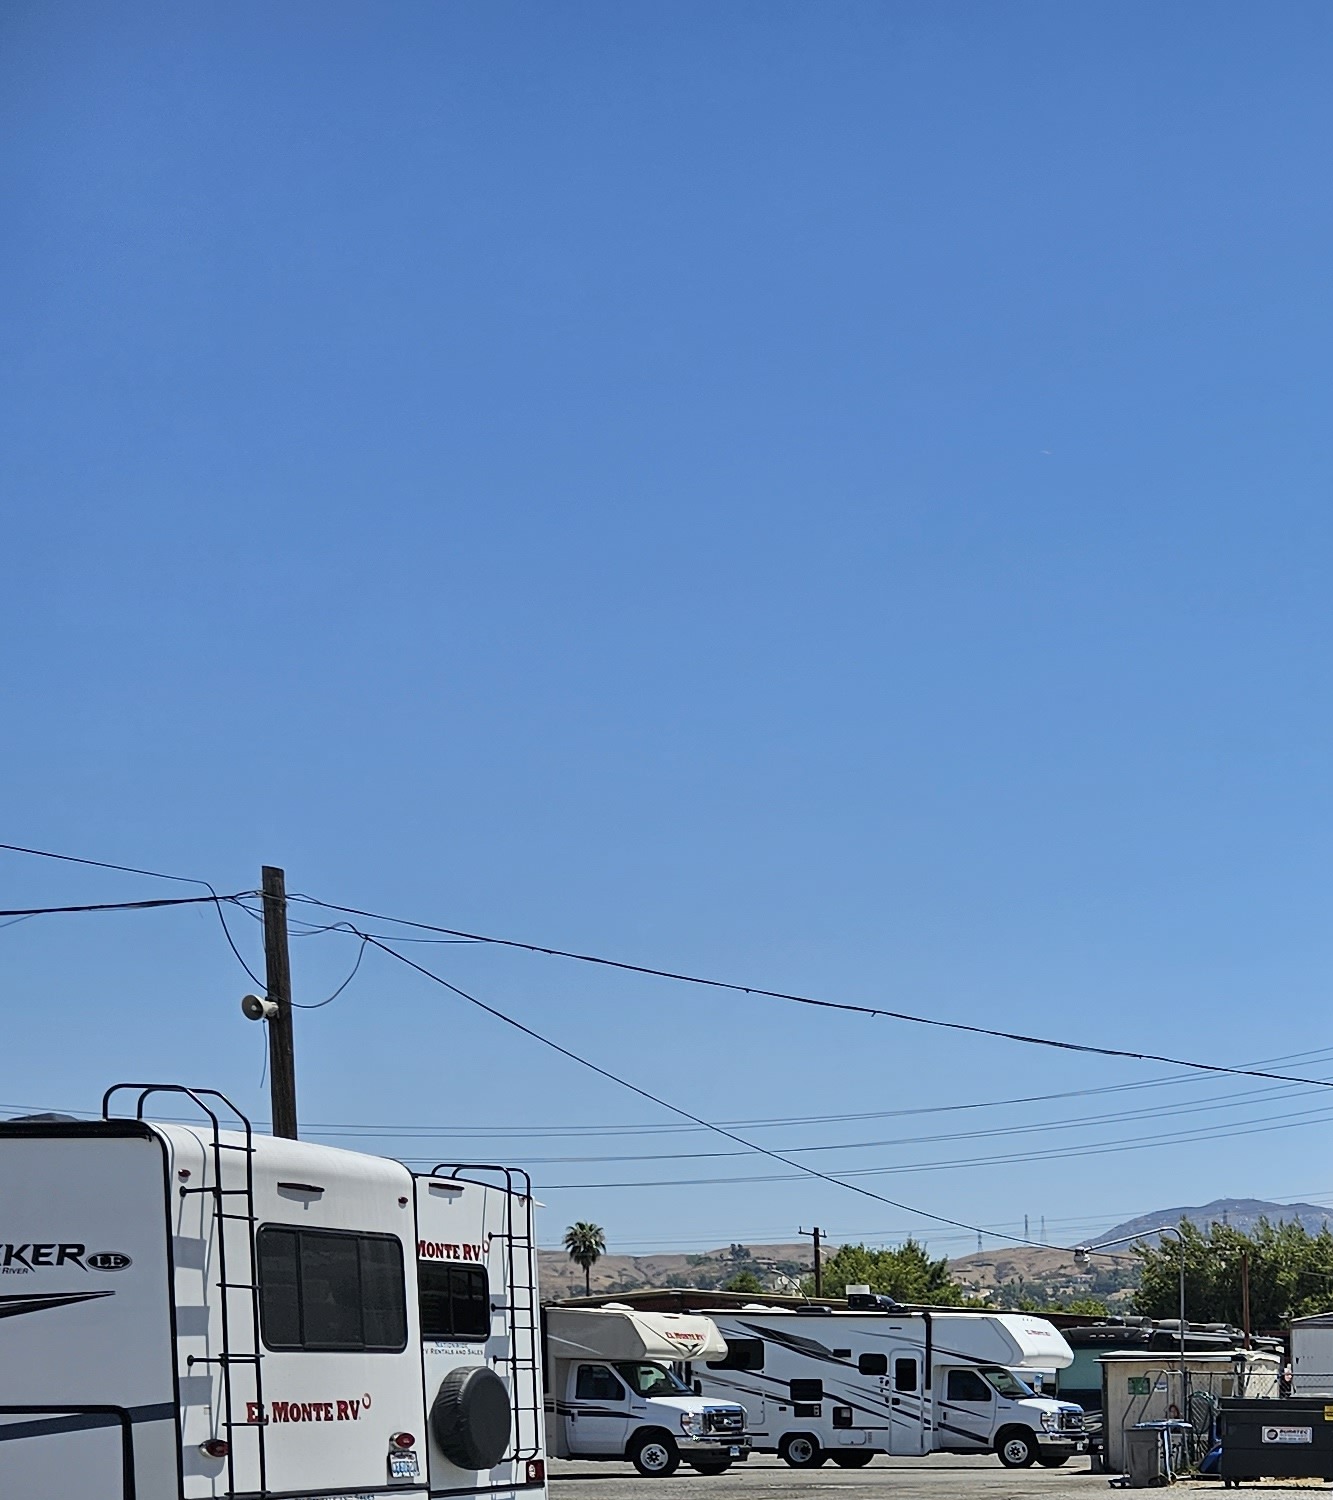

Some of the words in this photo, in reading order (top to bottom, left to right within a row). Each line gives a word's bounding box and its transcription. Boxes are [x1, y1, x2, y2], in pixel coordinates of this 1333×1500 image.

[0, 1244, 88, 1272] KER
[462, 1244, 480, 1261] RV
[271, 1402, 333, 1423] MONTE
[336, 1399, 360, 1421] RV
